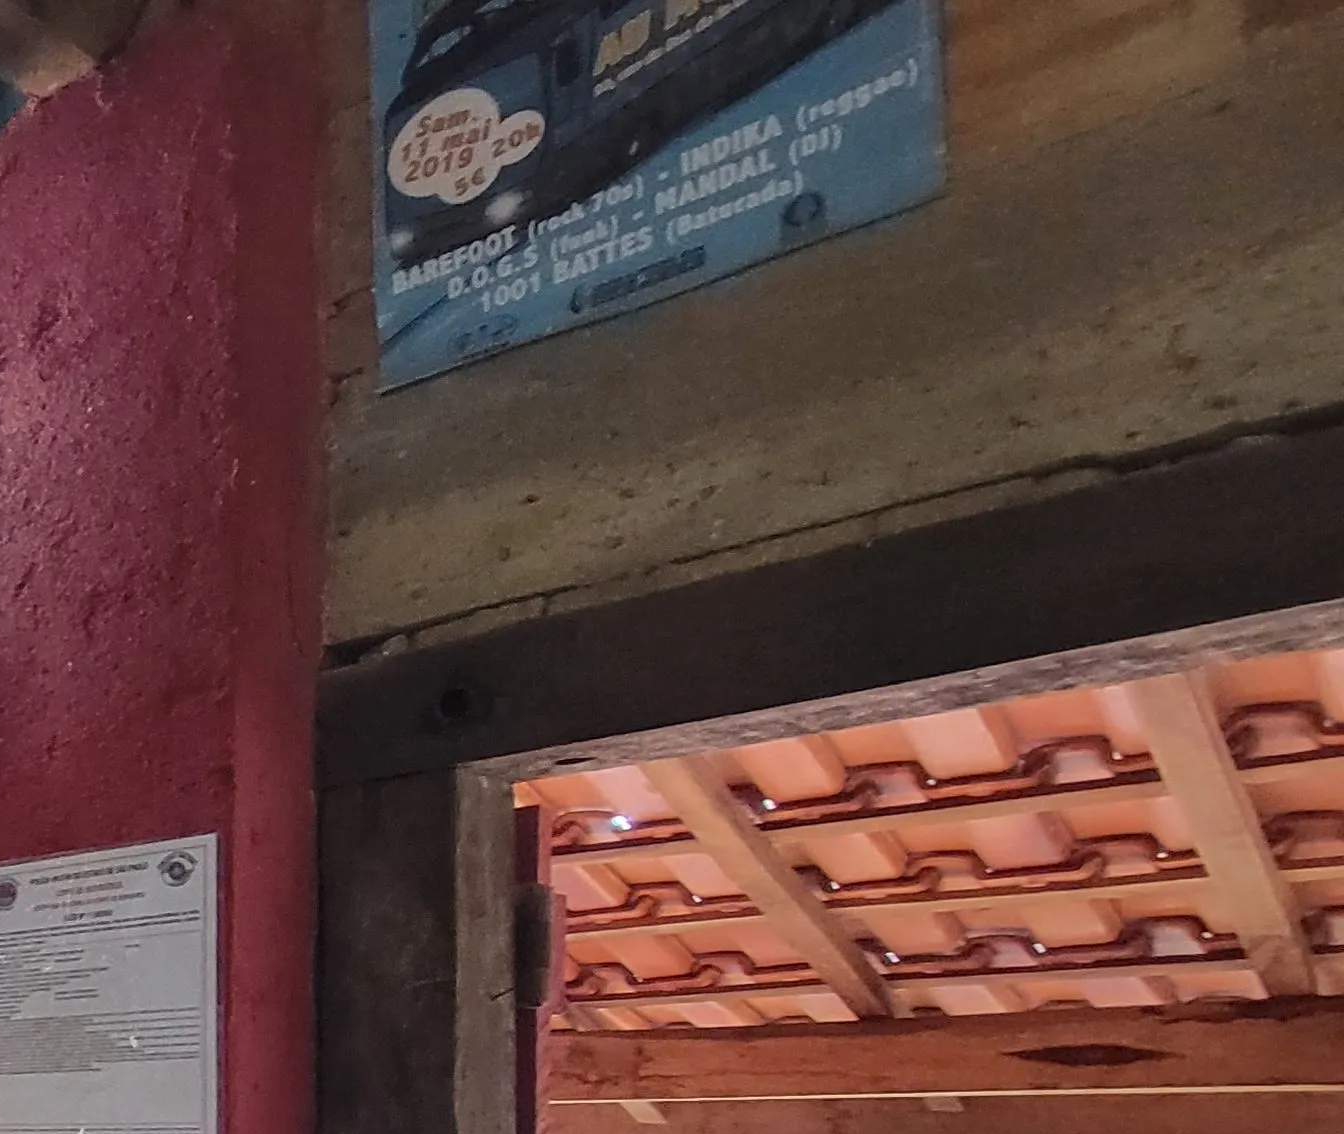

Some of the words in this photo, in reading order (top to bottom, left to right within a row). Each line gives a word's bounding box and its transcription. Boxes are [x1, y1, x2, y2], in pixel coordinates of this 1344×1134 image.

[402, 139, 430, 162] 11
[404, 147, 473, 183] 2019
[654, 149, 776, 216] MANDAL
[392, 225, 517, 296] BAREFOOT
[680, 114, 783, 176] INDIKA
[481, 271, 541, 312] 1001
[553, 226, 653, 284] BATTES
